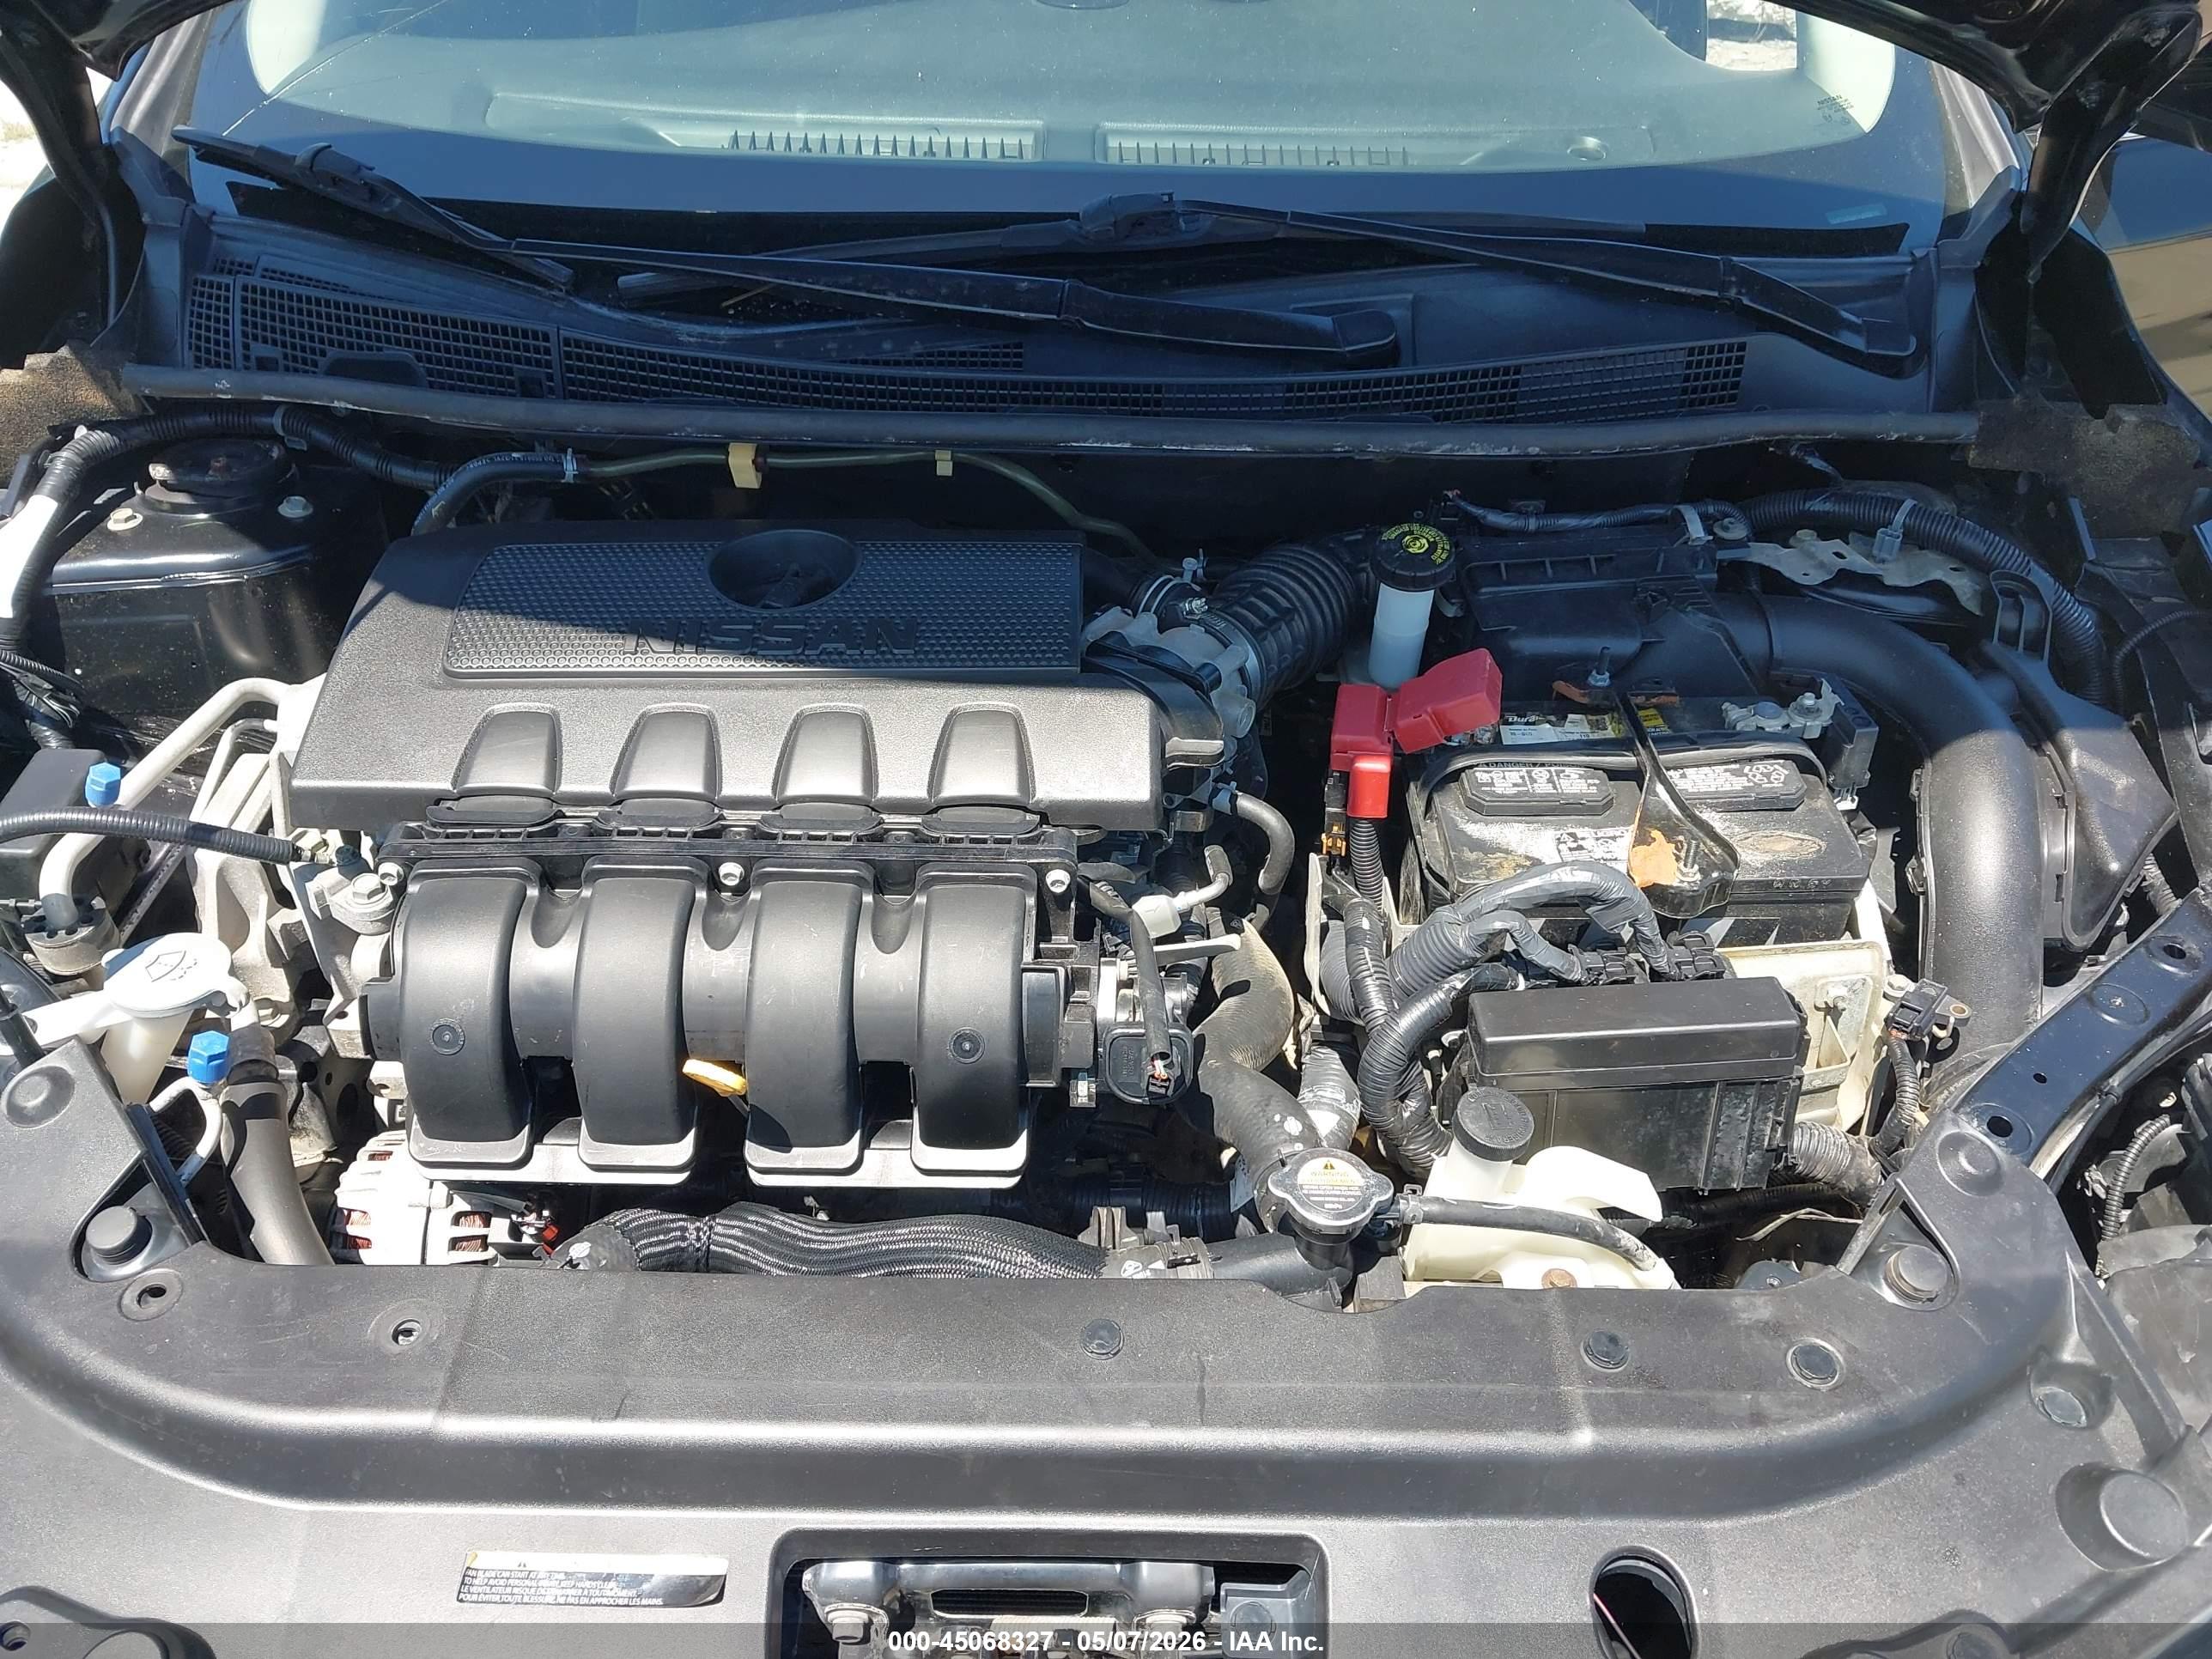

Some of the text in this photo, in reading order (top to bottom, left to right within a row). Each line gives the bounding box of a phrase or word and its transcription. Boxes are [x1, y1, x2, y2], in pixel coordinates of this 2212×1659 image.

[623, 618, 915, 654] NISSAN
[507, 1578, 538, 1587] PERSONAL
[470, 1585, 513, 1595] VENTILATEUR
[459, 1593, 478, 1601] POUR
[589, 1596, 629, 1605] APPROCHER
